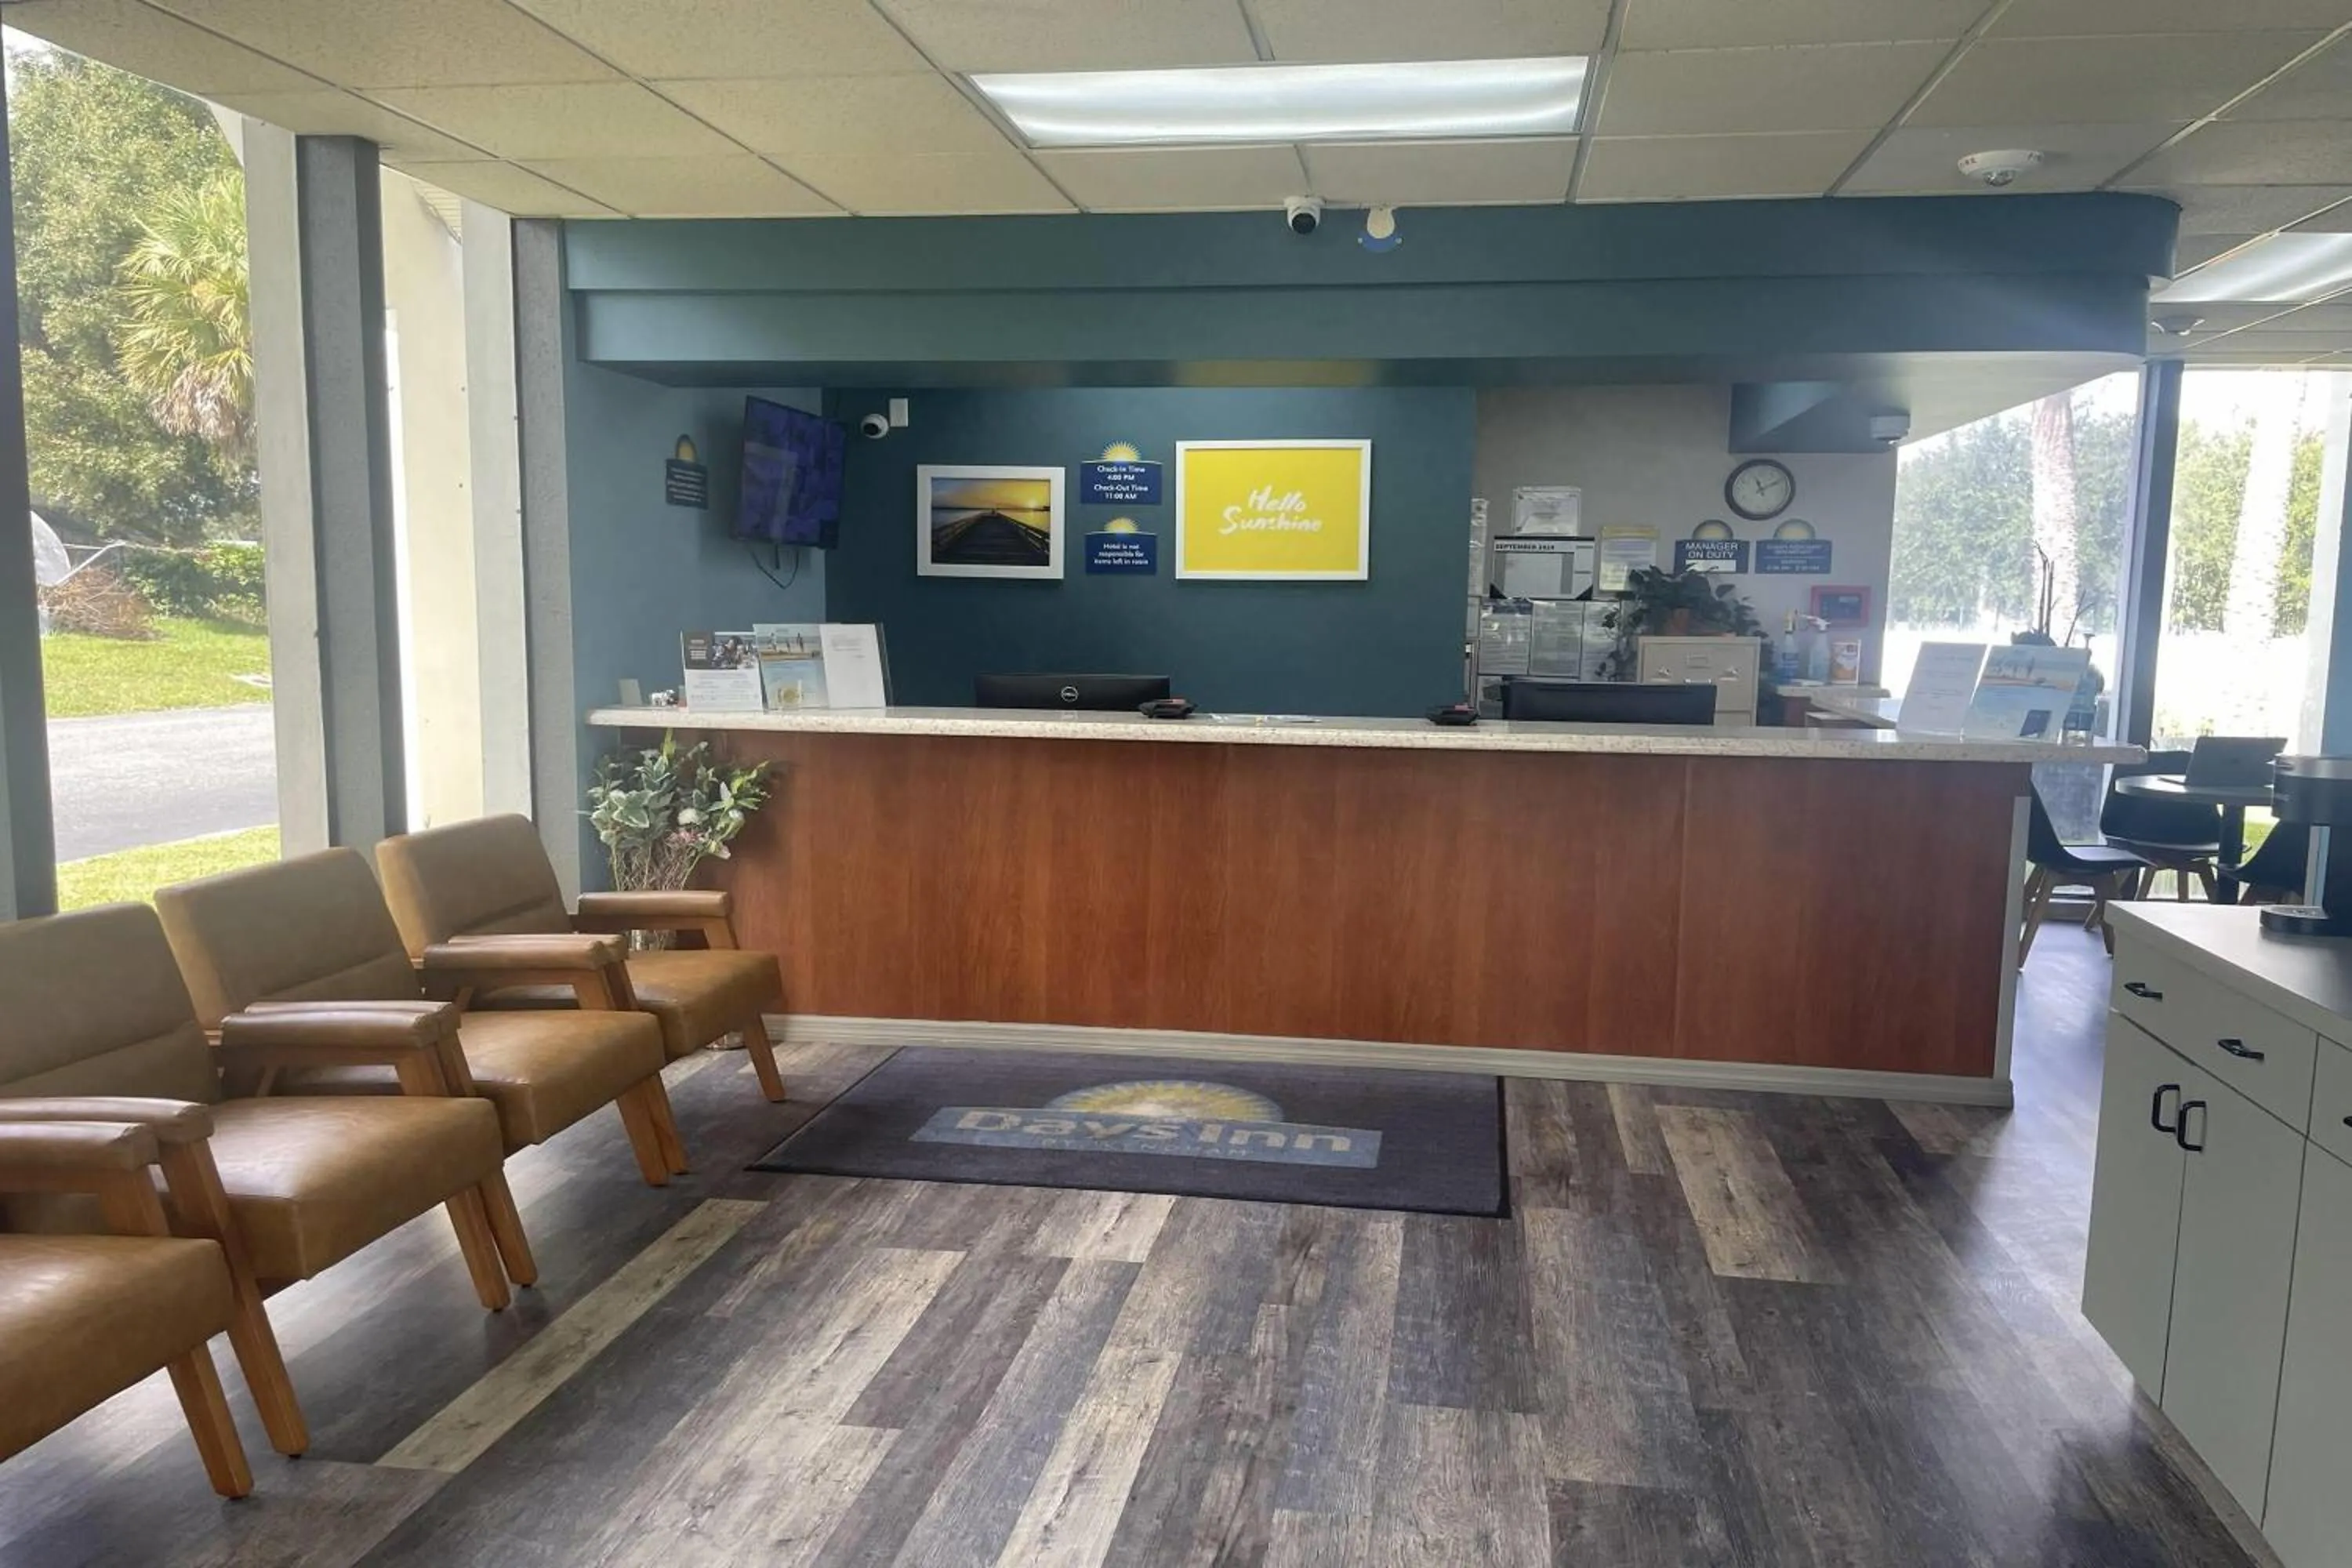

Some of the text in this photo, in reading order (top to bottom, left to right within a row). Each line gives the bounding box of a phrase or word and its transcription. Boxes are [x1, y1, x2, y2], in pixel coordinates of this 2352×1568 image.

[1248, 485, 1307, 512] Hello
[1218, 506, 1323, 535] Sunshine
[1685, 542, 1738, 550] MANAGER
